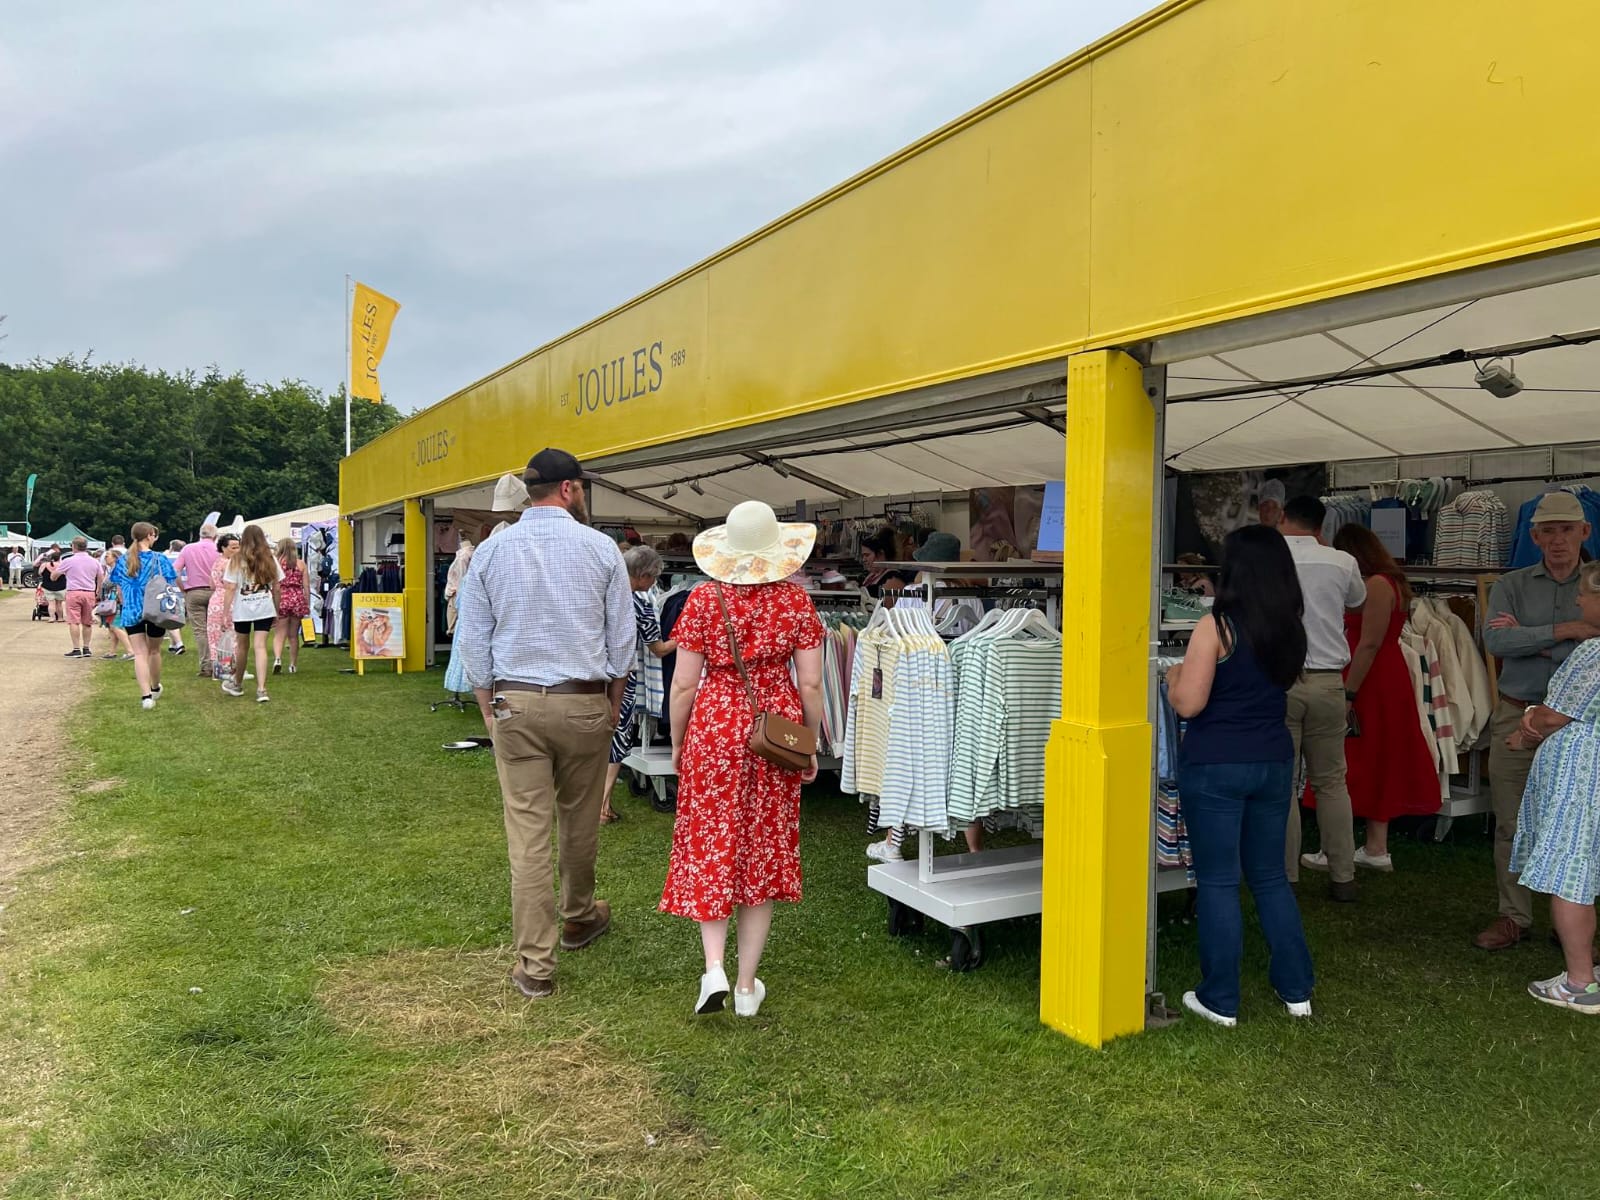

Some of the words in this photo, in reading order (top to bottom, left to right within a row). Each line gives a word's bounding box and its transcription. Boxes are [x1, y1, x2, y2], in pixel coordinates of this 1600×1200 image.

[560, 393, 569, 408] EST
[575, 341, 663, 416] JOULES
[670, 348, 686, 369] 1989
[416, 429, 449, 467] JOULES
[361, 595, 397, 604] JOULES
